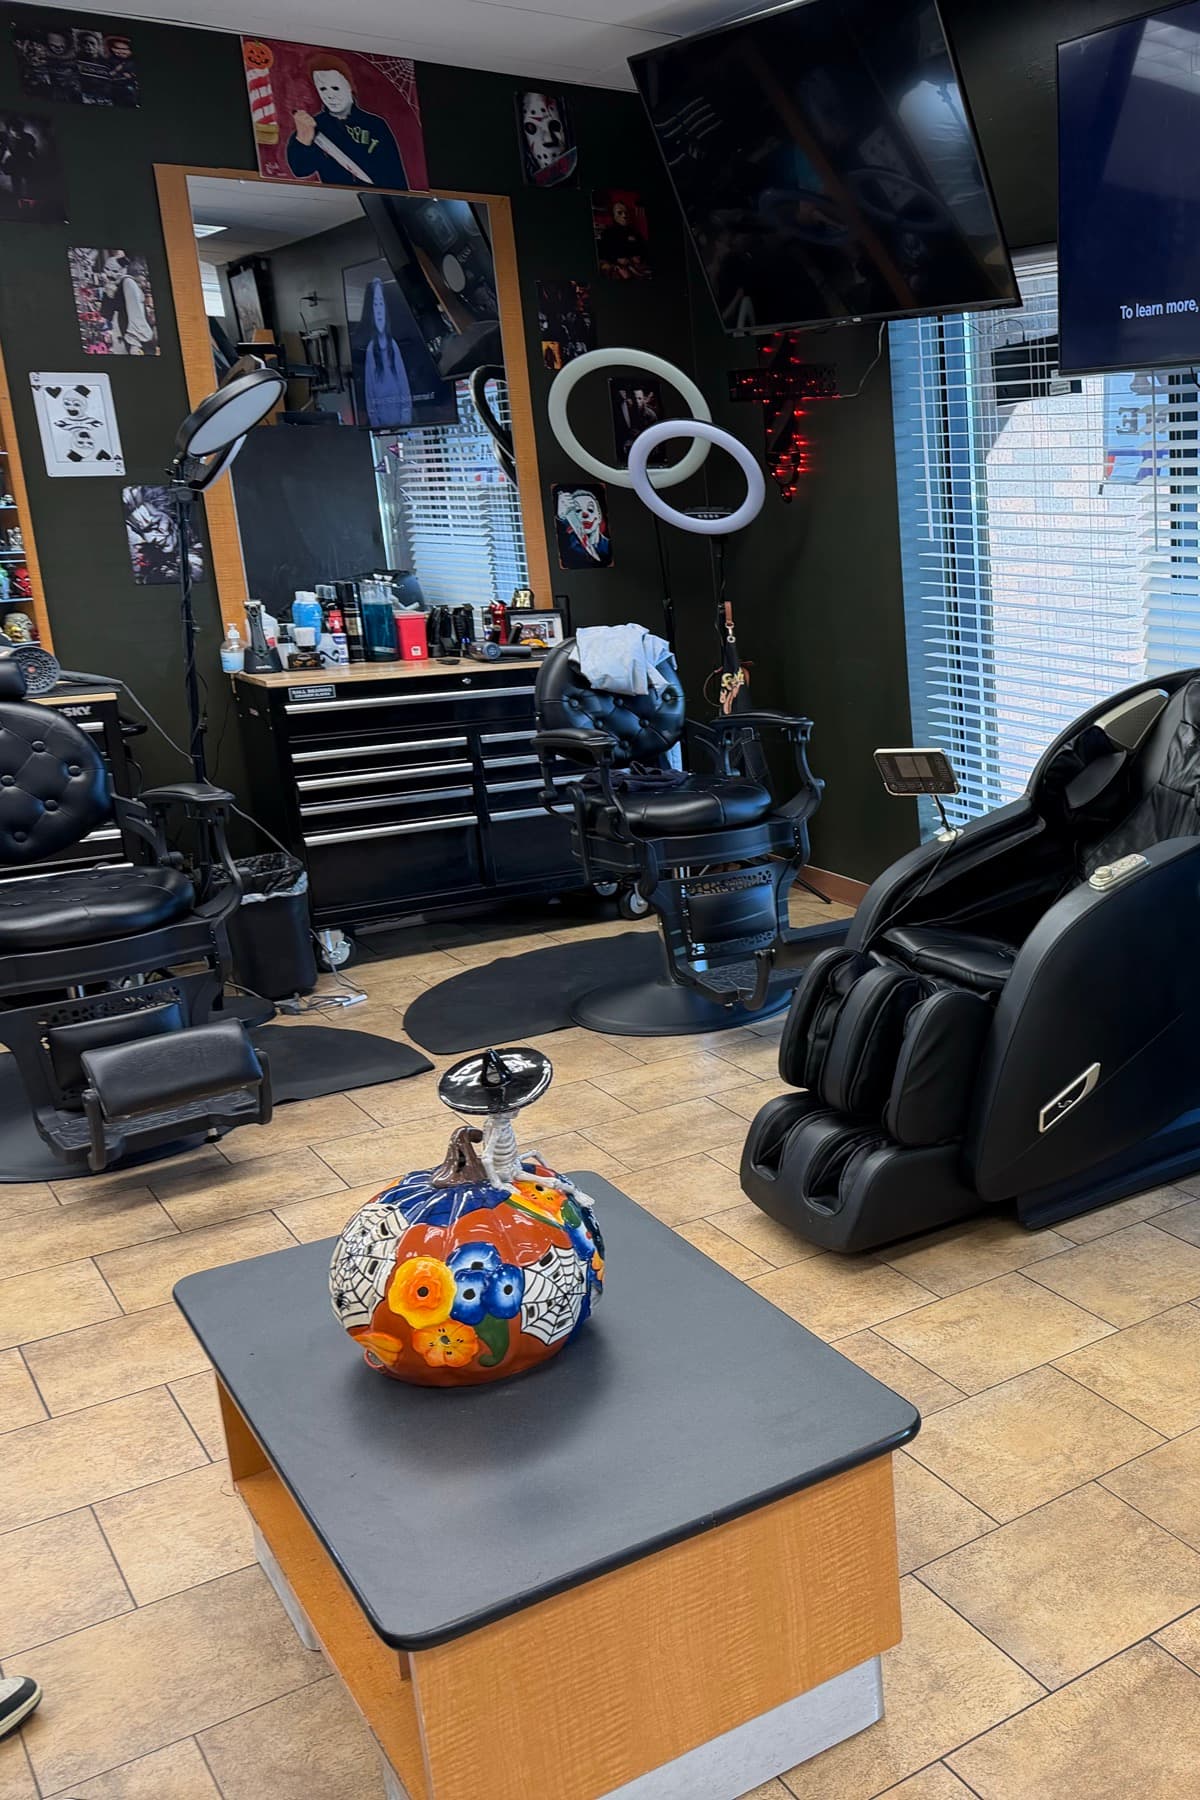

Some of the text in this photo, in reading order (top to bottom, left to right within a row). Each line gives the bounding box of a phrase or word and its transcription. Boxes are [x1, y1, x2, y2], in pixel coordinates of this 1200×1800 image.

[1120, 304, 1134, 321] To
[1136, 302, 1163, 318] learn
[1166, 299, 1199, 317] more,
